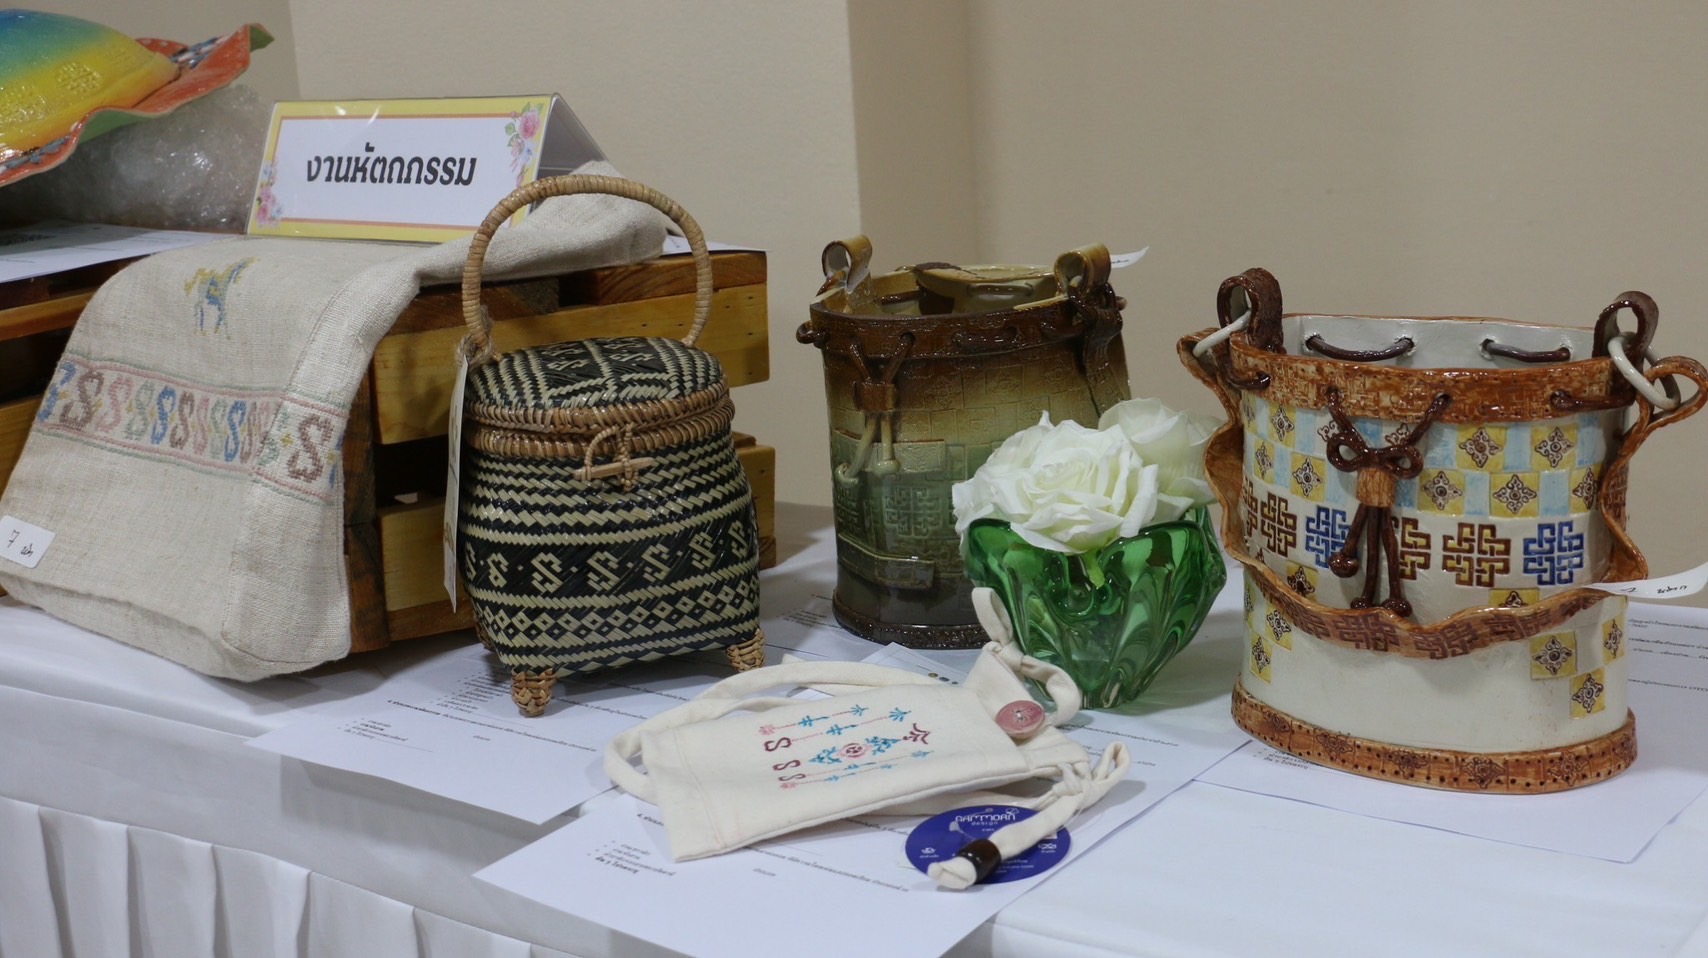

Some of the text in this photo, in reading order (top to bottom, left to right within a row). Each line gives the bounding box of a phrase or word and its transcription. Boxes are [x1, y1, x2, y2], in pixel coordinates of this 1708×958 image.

[307, 142, 477, 186] งานหัตถกรรม
